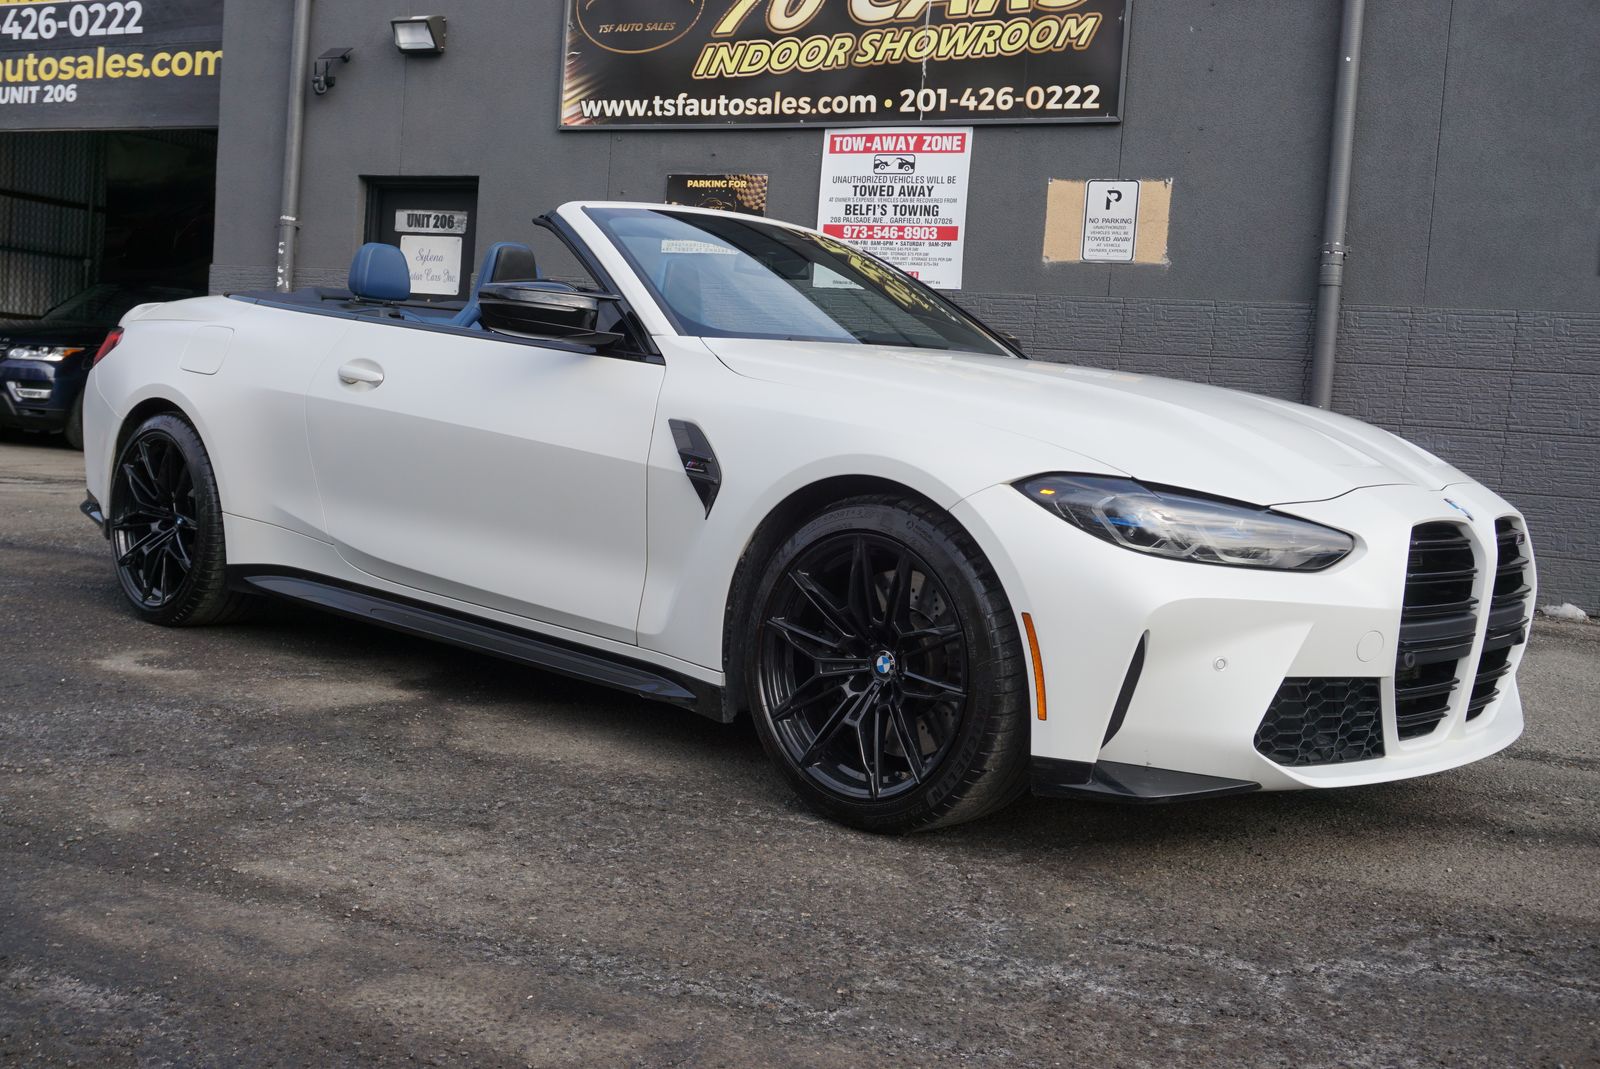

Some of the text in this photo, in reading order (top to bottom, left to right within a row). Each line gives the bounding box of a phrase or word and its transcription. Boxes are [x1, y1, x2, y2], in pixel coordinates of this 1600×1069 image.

[0, 1, 143, 40] 426-0222
[599, 22, 676, 33] TSF AUTO SALES
[692, 13, 1102, 79] INDOOR SHOWROOM
[0, 46, 223, 82] utosales.com
[0, 84, 77, 104] UNIT 206
[580, 84, 1100, 117] www.tsfautosales.com 201-426-0222
[834, 135, 962, 152] TOW-AWAY ZONE
[687, 180, 747, 188] PARKING FOR
[832, 175, 957, 184] UNAUTHORIZED VEHICLES WILL BE
[852, 185, 935, 198] TOWED AWAY
[844, 204, 940, 217] BELFI'S TOWING
[406, 213, 455, 229] UNIT 206
[843, 226, 938, 239] 973-546-8903
